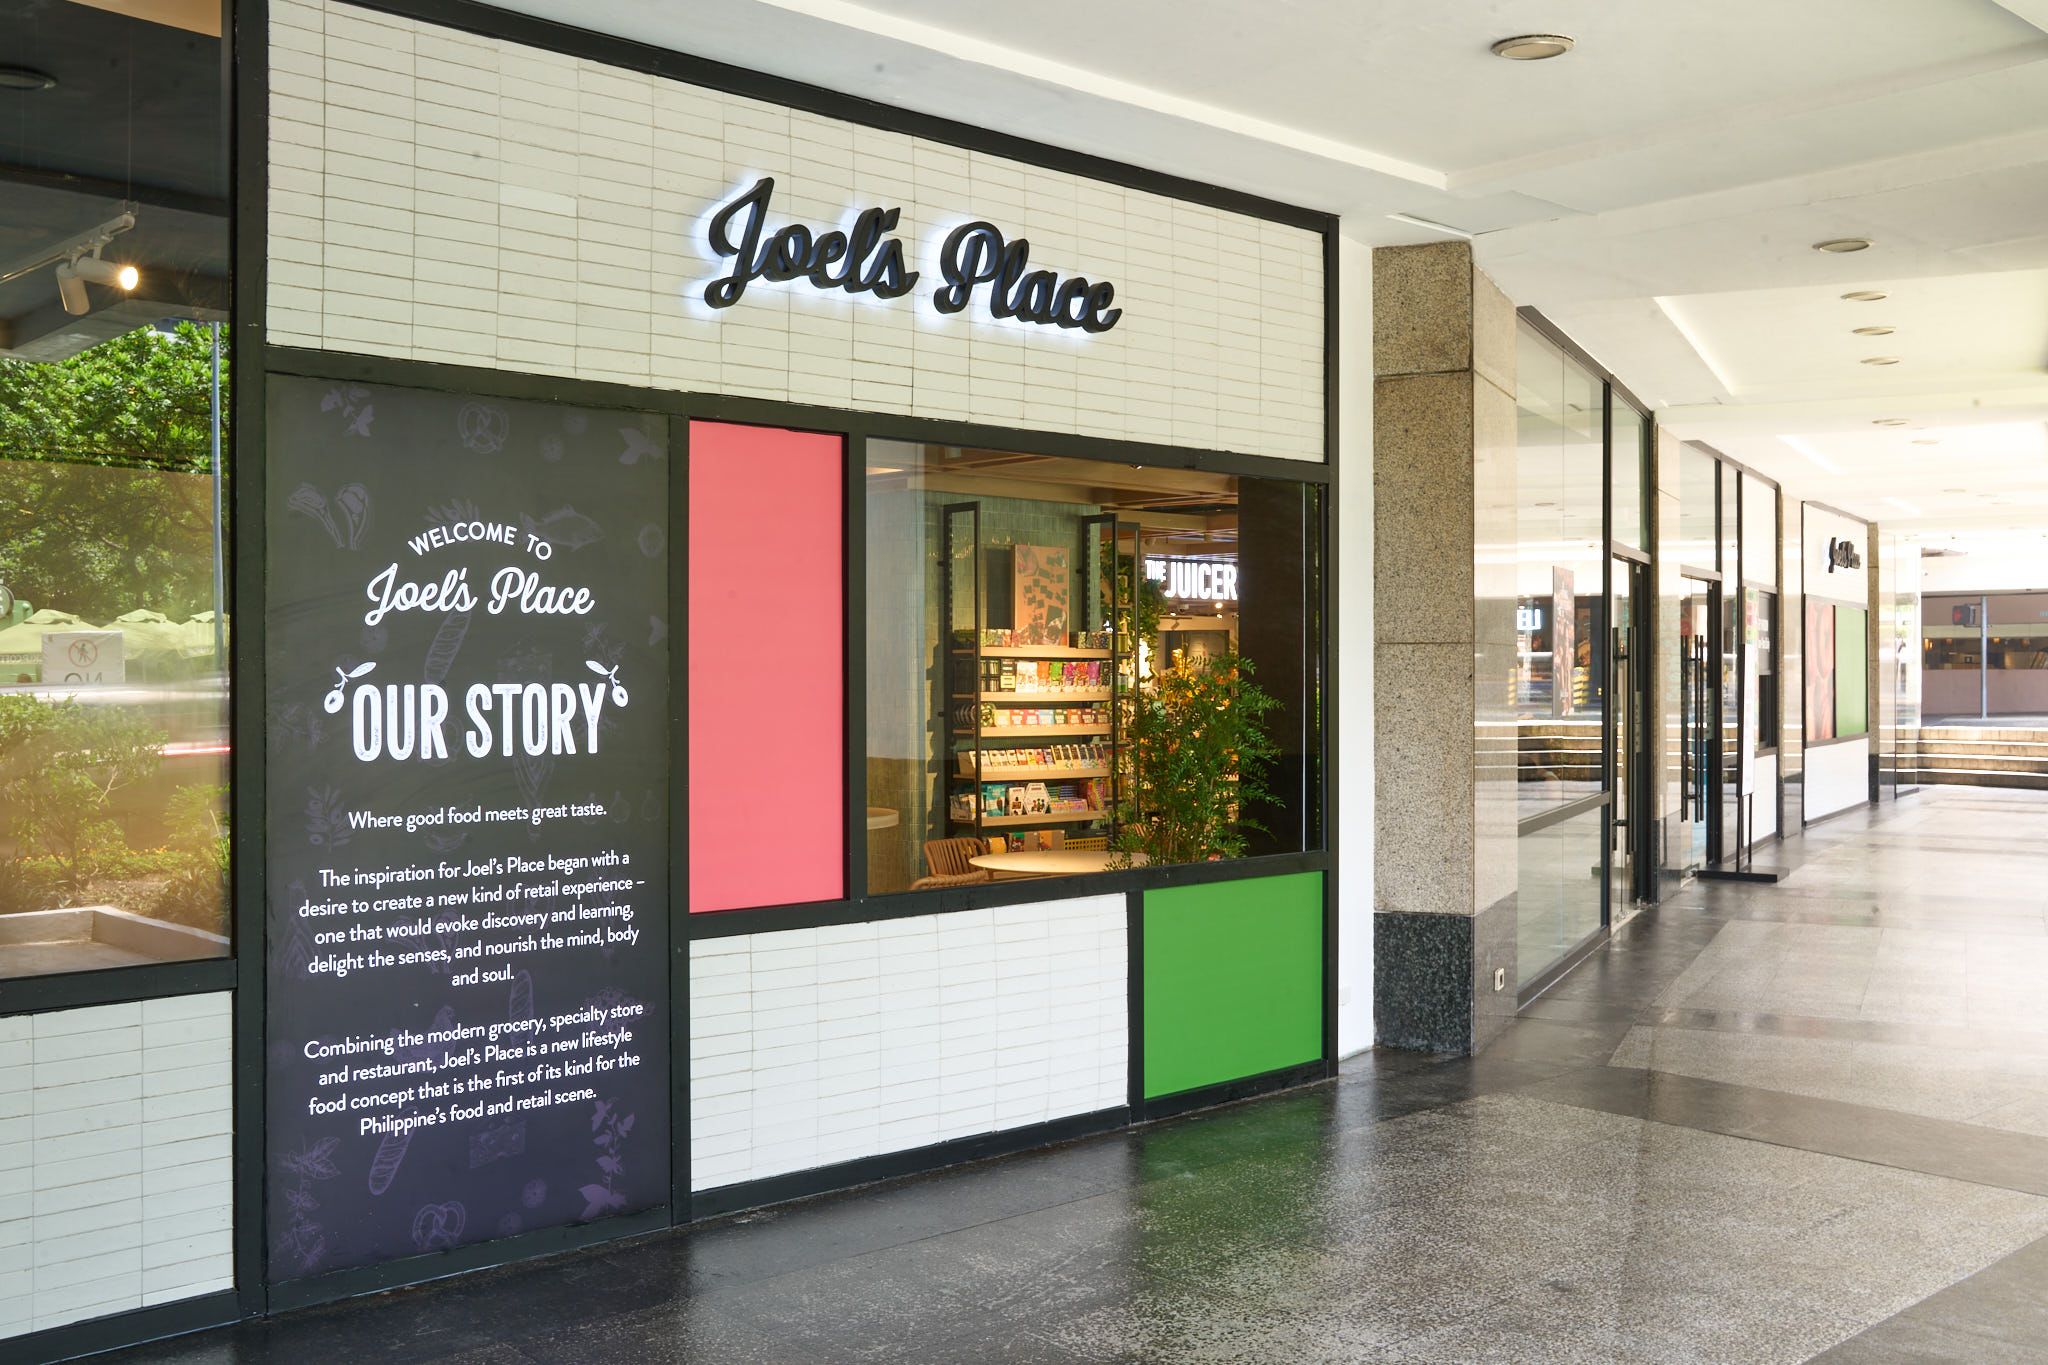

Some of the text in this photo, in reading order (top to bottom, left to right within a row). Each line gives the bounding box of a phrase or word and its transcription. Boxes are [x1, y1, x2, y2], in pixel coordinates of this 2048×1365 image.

[704, 176, 1123, 334] Joel's Place
[407, 521, 553, 561] WELCOME TO
[364, 562, 596, 626] Joel's Place
[1144, 559, 1167, 582] THE
[352, 683, 607, 762] OUR STORY
[347, 802, 608, 833] Where good food meets great taste.
[318, 849, 630, 891] The inspiration for Joel's Place began with a
[298, 897, 349, 918] desire
[351, 899, 370, 914] to
[372, 894, 423, 912] create
[425, 895, 435, 908] a
[438, 893, 469, 907] new
[471, 884, 503, 904] kind
[505, 882, 523, 901] of
[524, 879, 559, 899] retail
[561, 876, 634, 901] experience
[314, 900, 635, 945] one that would evoke discovery and learning,
[307, 924, 640, 978] delight the senses, and nourish the mind, body
[451, 963, 515, 987] and soul.
[303, 1004, 644, 1059] Combining the modern grocery, specialty store
[318, 1026, 633, 1086] and restaurant, Joel's Place is a new lifestyle
[308, 1051, 641, 1116] food concept that is the first of its kind for the
[360, 1088, 597, 1137] Philippine's food and retail scene.
